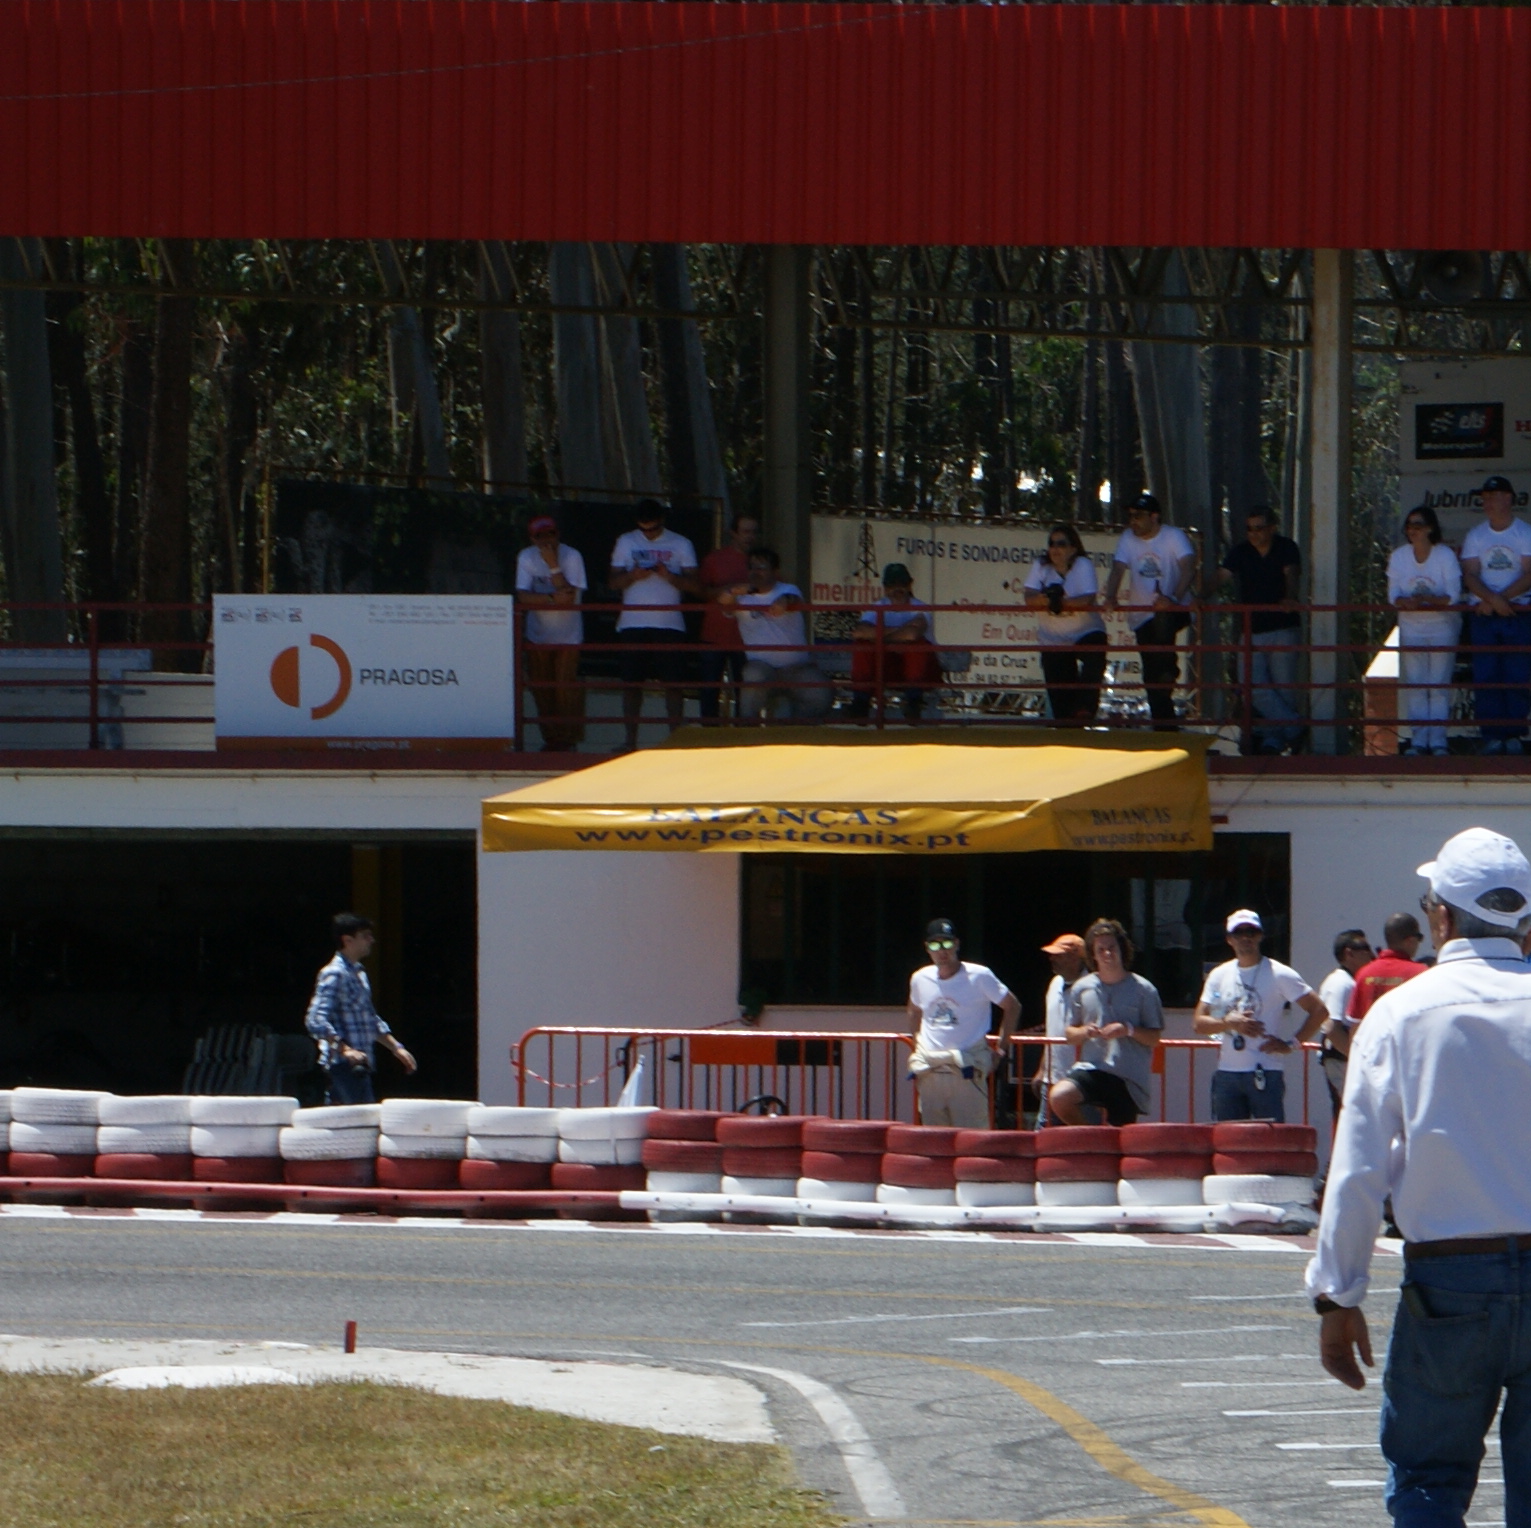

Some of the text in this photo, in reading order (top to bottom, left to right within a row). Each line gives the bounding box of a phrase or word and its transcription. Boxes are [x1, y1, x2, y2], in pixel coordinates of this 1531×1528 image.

[896, 537, 944, 558] FUROS
[949, 543, 958, 560] E
[360, 668, 460, 687] PRAGOSA
[649, 807, 899, 828] BALANÇAS
[1091, 807, 1171, 826] BALANÇAS
[576, 828, 972, 850] www.pestronix.pt
